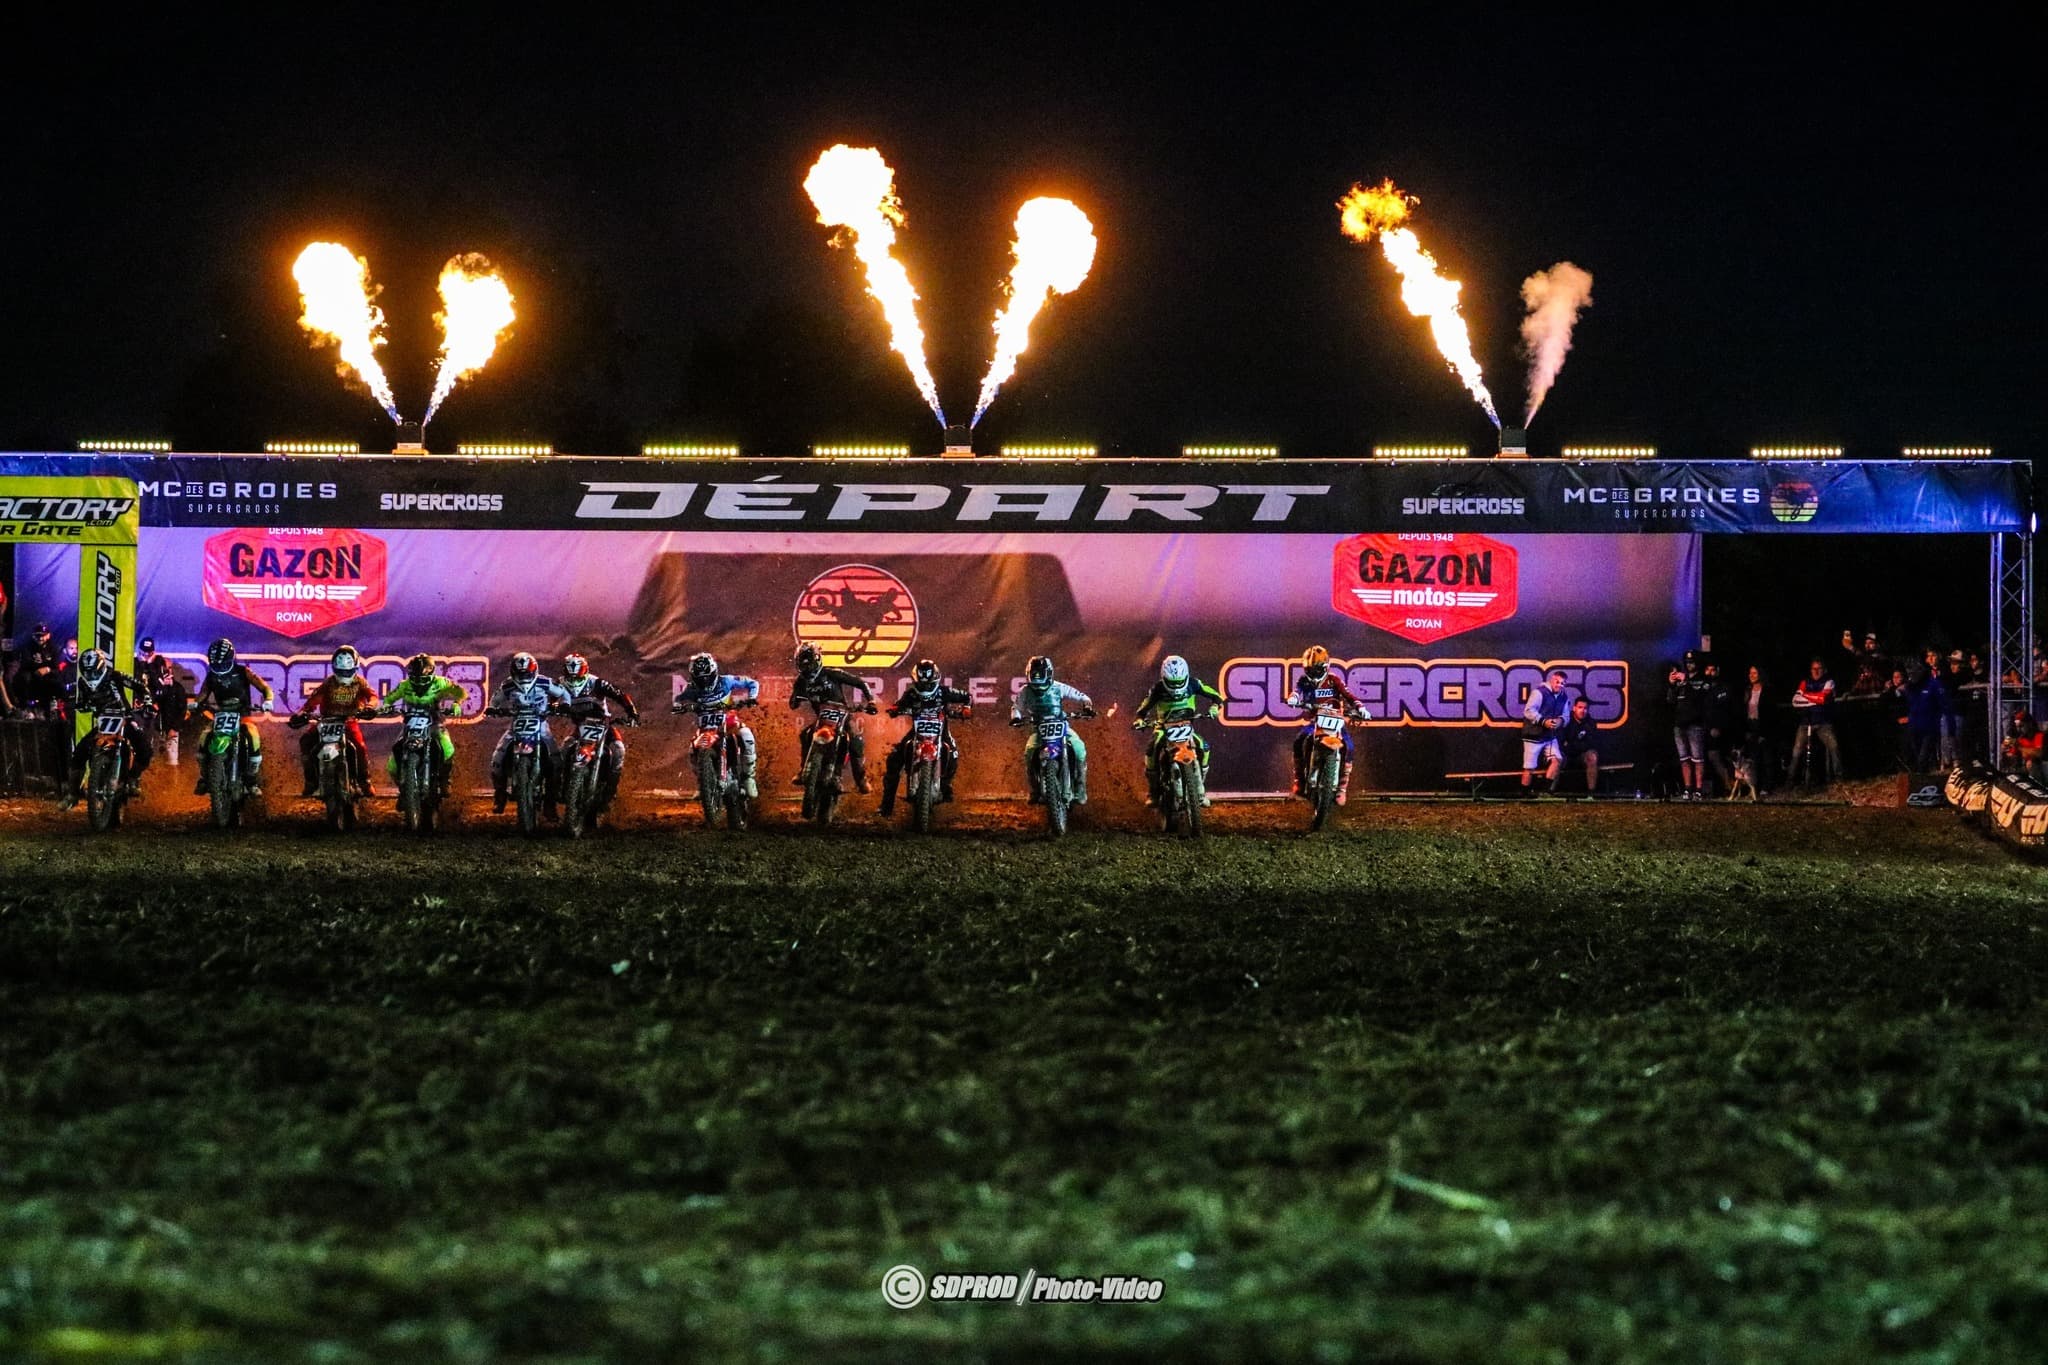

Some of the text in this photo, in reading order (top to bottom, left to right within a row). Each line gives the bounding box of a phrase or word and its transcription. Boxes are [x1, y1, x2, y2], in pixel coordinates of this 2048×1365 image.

[138, 481, 337, 498] MC DES GROIES
[1564, 487, 1760, 504] MC DES GROIES
[380, 493, 503, 511] SUPERCROSS
[575, 475, 1331, 521] DÉPART
[188, 503, 280, 514] SUPERCROSS
[1402, 498, 1525, 515] SUPERCROSS
[1615, 508, 1705, 519] SUPERCROSS
[21, 522, 84, 536] GATE
[268, 527, 300, 535] DEPUIS
[1398, 533, 1454, 542] DEPUIS 1948
[229, 542, 362, 579] GAZON
[1358, 547, 1493, 586] GAZON
[264, 581, 327, 600] motos
[1393, 587, 1458, 607] motos
[276, 611, 312, 623] ROYAN
[1405, 618, 1442, 629] ROYAN
[99, 717, 120, 733] 11
[514, 719, 539, 732] 92
[583, 726, 603, 740] 72
[1039, 722, 1063, 737] 389
[1166, 725, 1192, 742] 22
